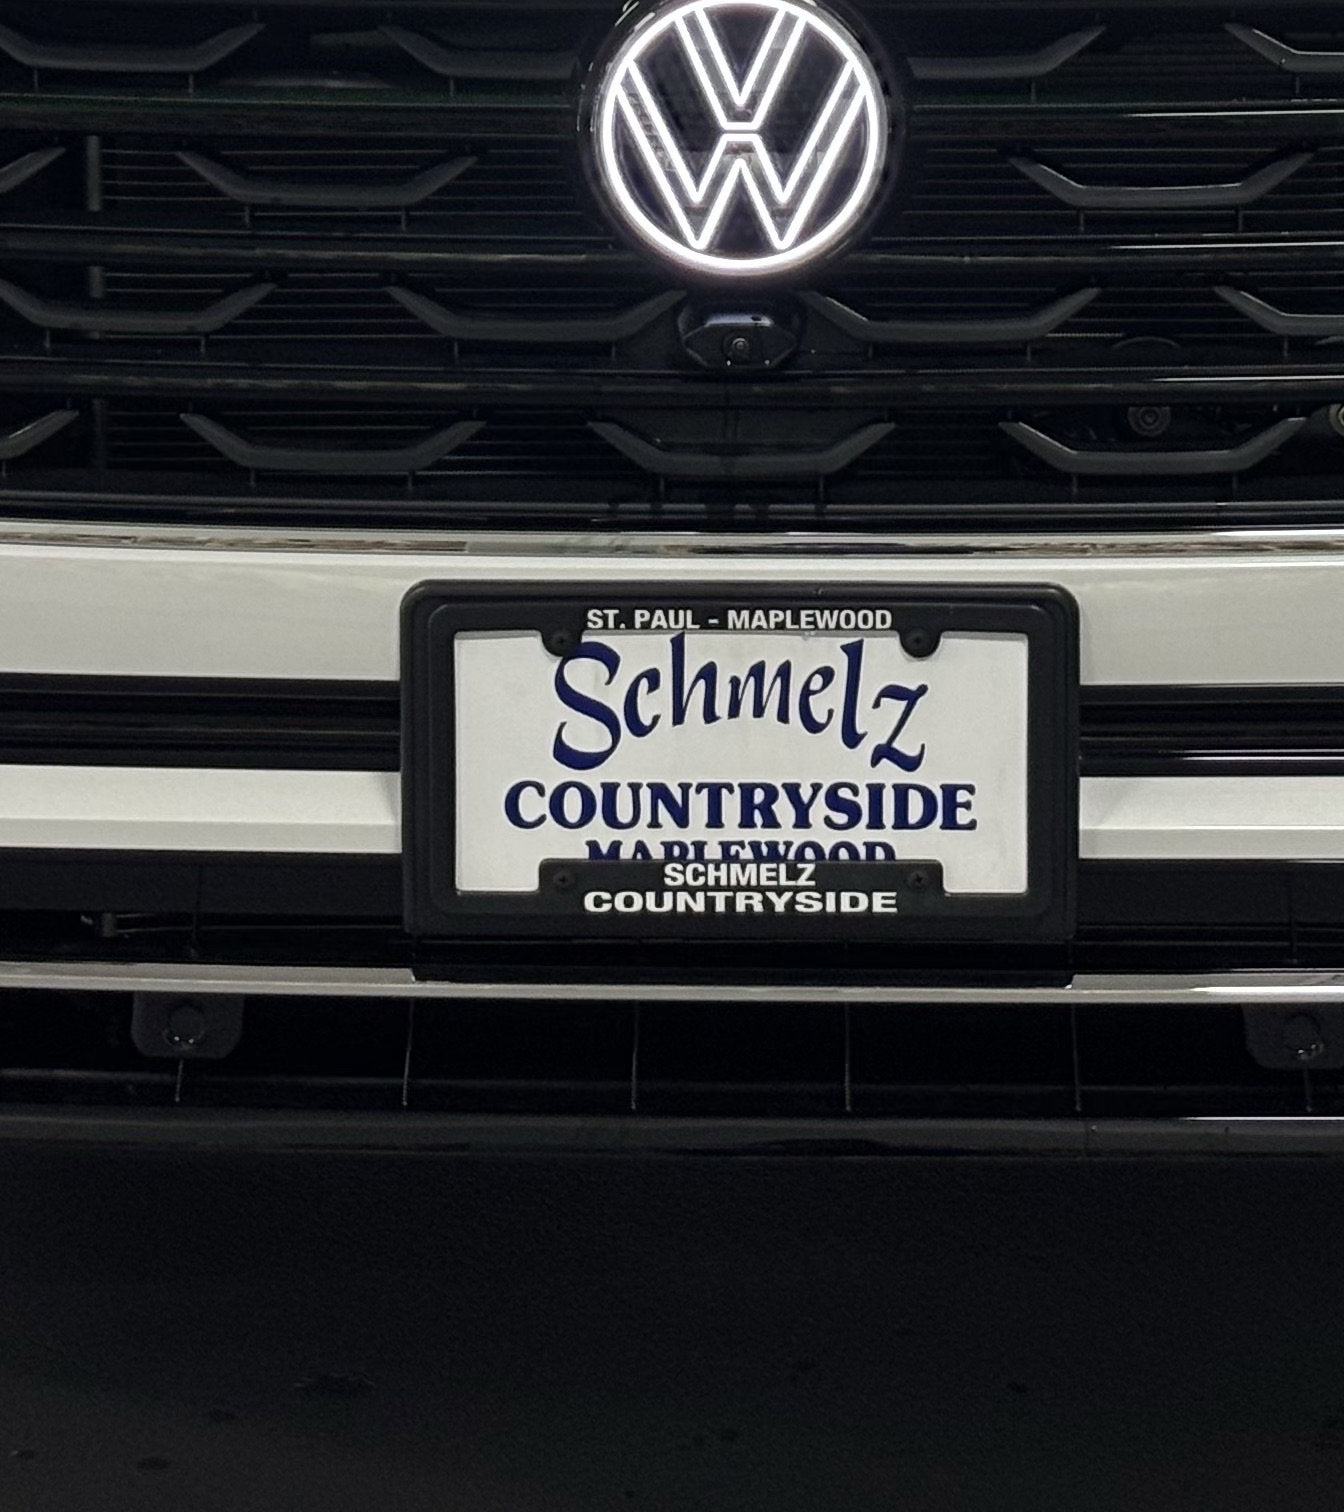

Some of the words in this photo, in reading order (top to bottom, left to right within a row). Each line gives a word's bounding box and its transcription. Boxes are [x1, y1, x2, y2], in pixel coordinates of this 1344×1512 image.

[586, 608, 626, 630] ST.
[633, 608, 701, 630] PAUL
[726, 608, 893, 630] MAPLEWOOD
[552, 631, 929, 772] Schmelz
[503, 779, 978, 831] COUNTRYSIDE
[663, 862, 817, 887] SCHMELZ
[583, 890, 899, 914] COUNTRYSIDE
